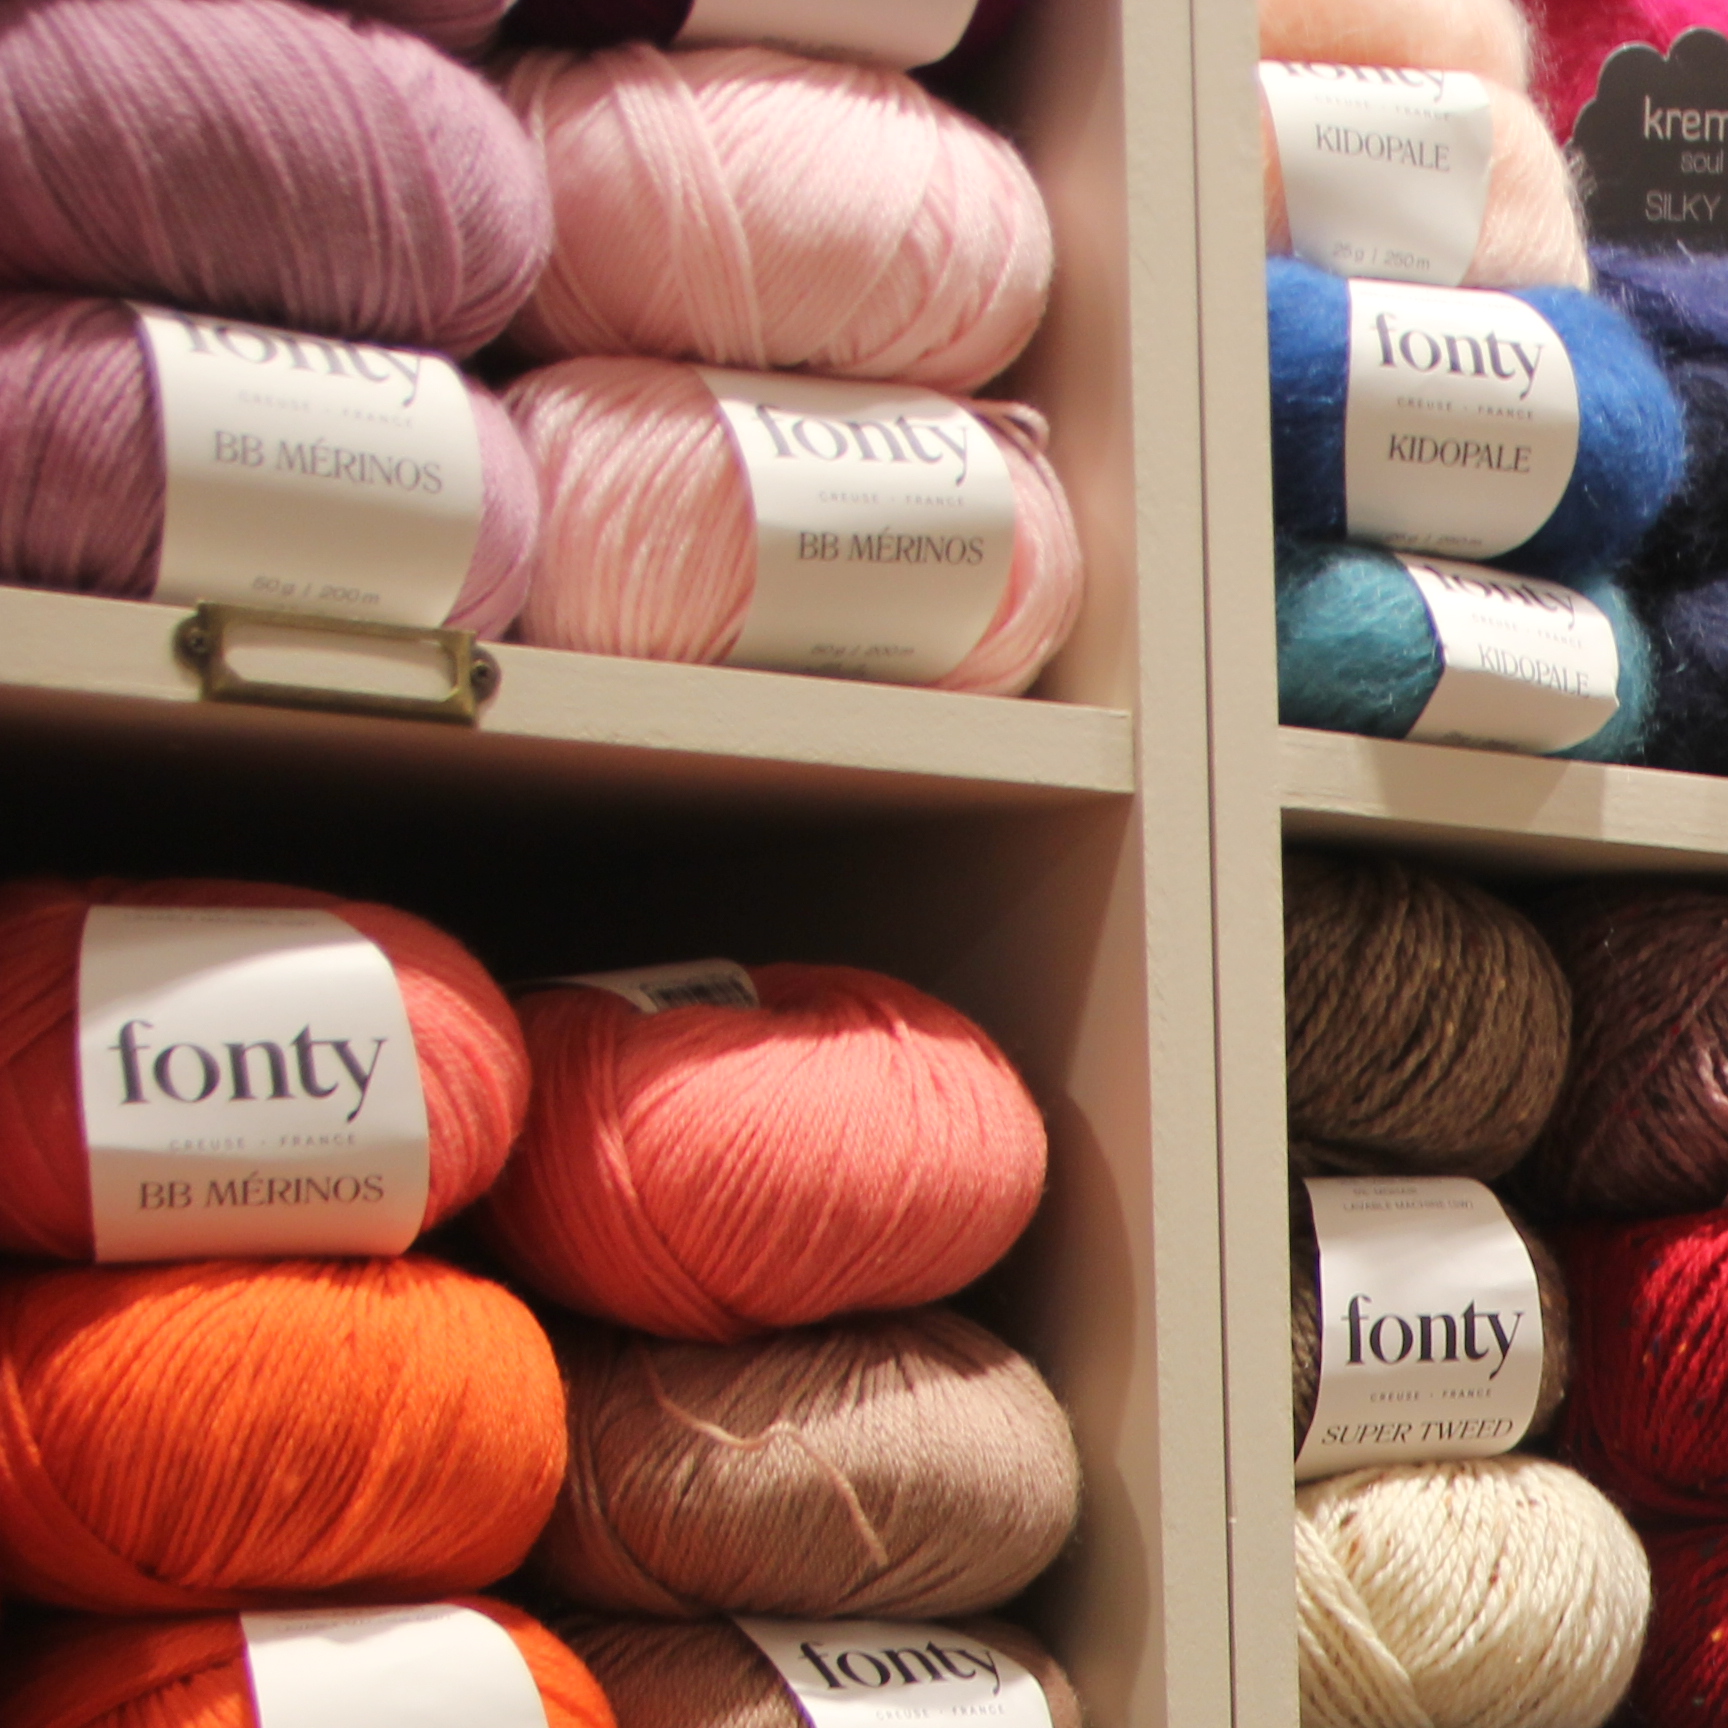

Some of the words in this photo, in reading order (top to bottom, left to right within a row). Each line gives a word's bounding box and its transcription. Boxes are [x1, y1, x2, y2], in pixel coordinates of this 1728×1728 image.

[1314, 123, 1450, 173] KIDOPALE
[1681, 149, 1724, 175] soul
[1644, 190, 1719, 223] SILKY
[1370, 311, 1546, 400] fonty
[213, 430, 264, 469] BB
[276, 437, 443, 495] MÉRINOS
[752, 403, 970, 487] fonty
[1387, 433, 1532, 474] KIDOPALE
[797, 531, 839, 563] BB
[847, 527, 984, 566] MÉRINOS
[1477, 643, 1589, 697] KIDOPALE
[108, 1019, 389, 1123] fonty
[169, 1138, 246, 1151] CREUSE
[279, 1133, 357, 1149] FRANCE
[139, 1180, 193, 1210] BB
[205, 1171, 384, 1209] MÉRINOS
[1341, 1293, 1525, 1381] fonty
[1371, 1391, 1420, 1402] CREUSE
[1442, 1388, 1492, 1400] FRANCE
[1321, 1423, 1412, 1445] SUPER
[1421, 1418, 1514, 1441] TWEED
[797, 1638, 1001, 1695] fonty
[952, 1702, 1006, 1717] FRANCE
